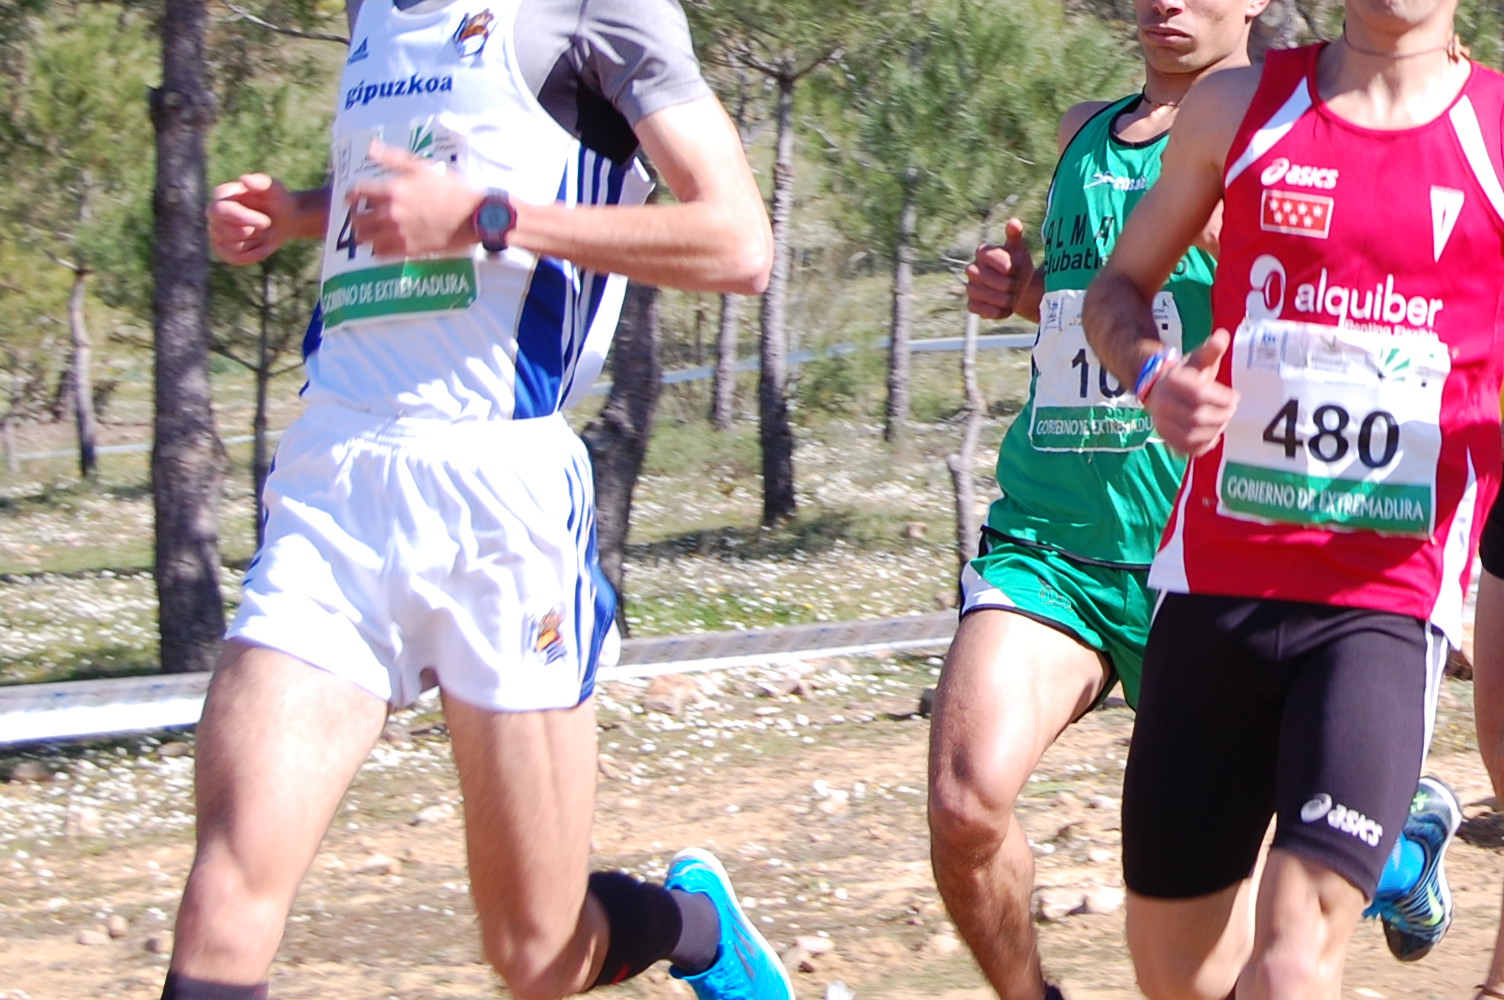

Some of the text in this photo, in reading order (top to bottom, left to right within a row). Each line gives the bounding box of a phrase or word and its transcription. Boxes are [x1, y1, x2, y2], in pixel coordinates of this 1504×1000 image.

[344, 72, 454, 111] gipuzkoa
[1284, 165, 1339, 190] asics
[375, 272, 471, 302] EXTREMADURA
[1294, 266, 1444, 328] alquiber
[1262, 398, 1401, 469] 480
[1227, 475, 1425, 523] GOBIERNO DE EXTREMADURA
[1327, 803, 1384, 847] asics
